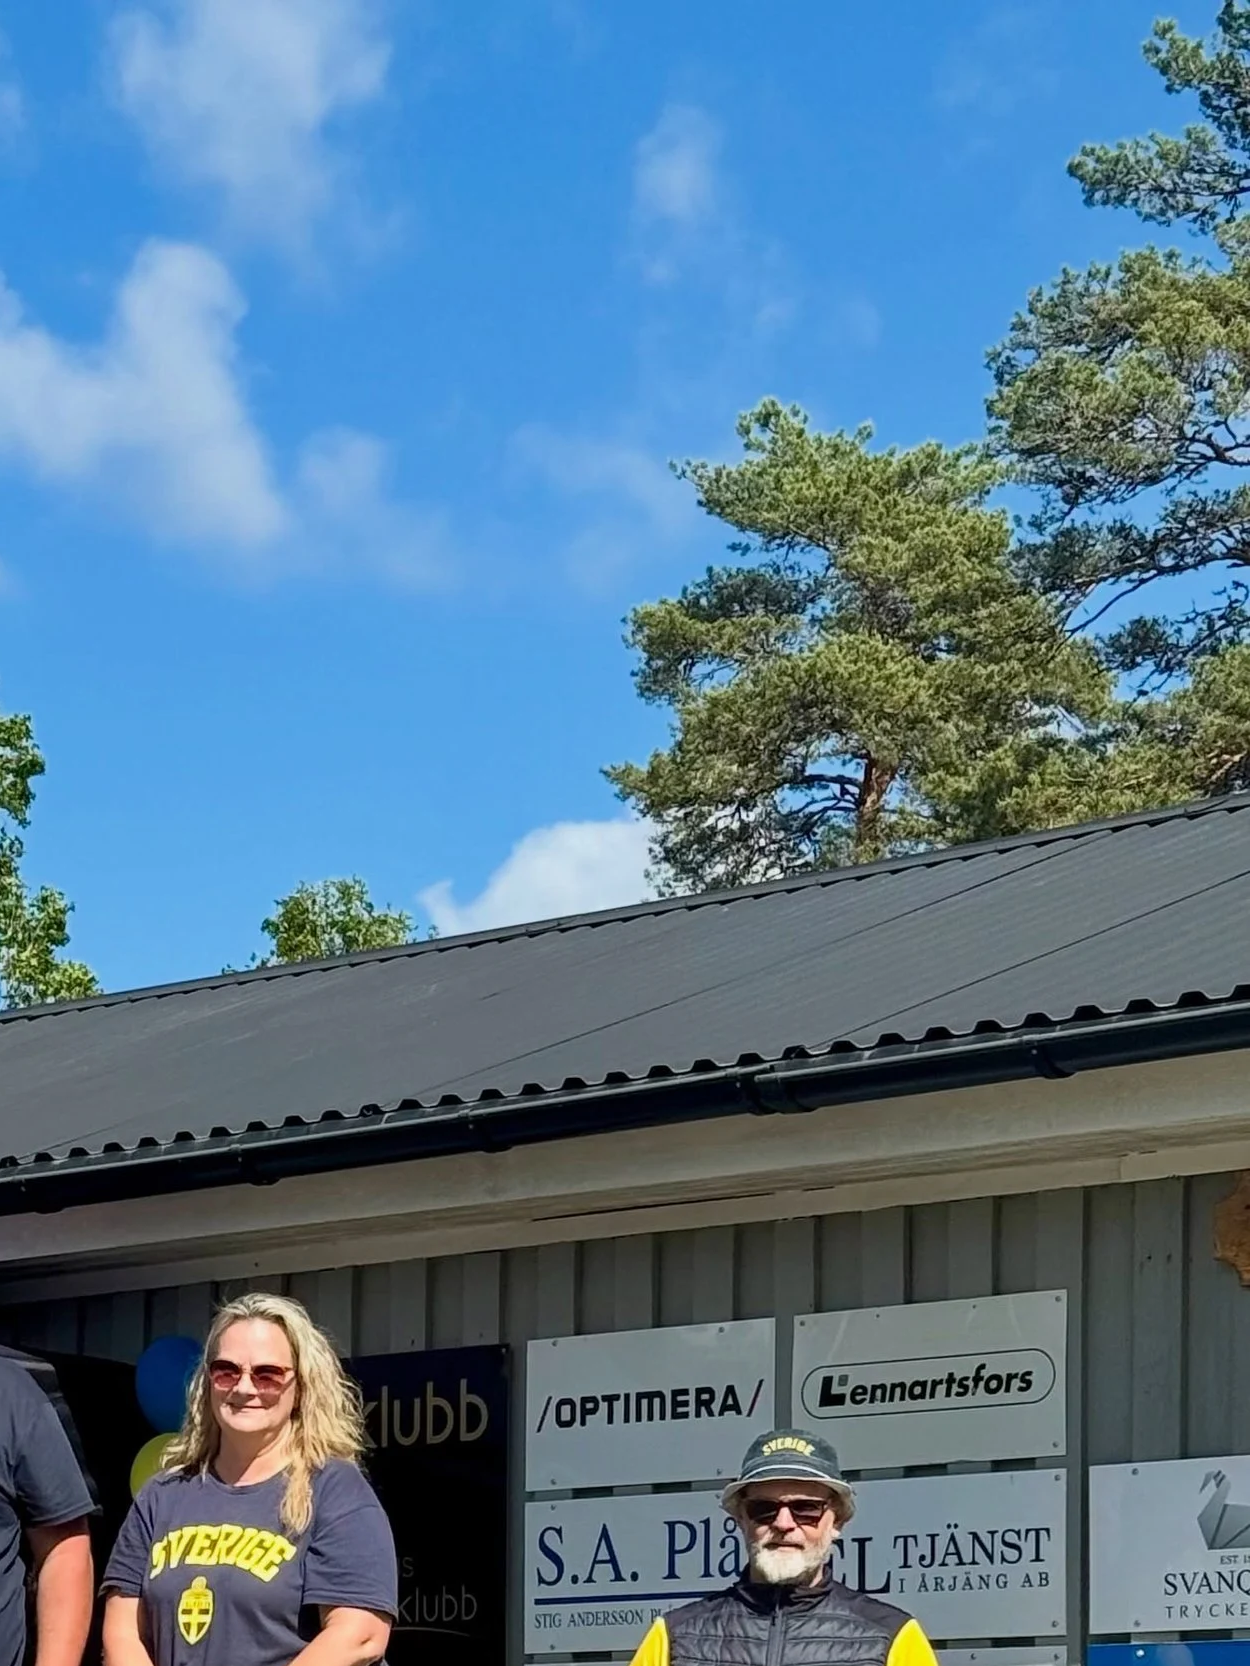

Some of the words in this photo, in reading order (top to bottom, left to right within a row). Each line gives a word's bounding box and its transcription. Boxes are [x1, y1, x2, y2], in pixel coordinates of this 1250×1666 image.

[818, 1363, 1034, 1408] Lennartsfors
[761, 1437, 816, 1456] SVERIGE
[149, 1523, 297, 1583] SVERIGE
[536, 1523, 639, 1587] S.A.
[893, 1523, 1051, 1569] TJÄNST
[917, 1569, 1008, 1593] ÅRJÄNG
[1021, 1571, 1051, 1589] AB
[534, 1612, 562, 1630] STIG
[567, 1608, 645, 1628] ANDERSSON
[1165, 1602, 1249, 1620] TRYCKE
